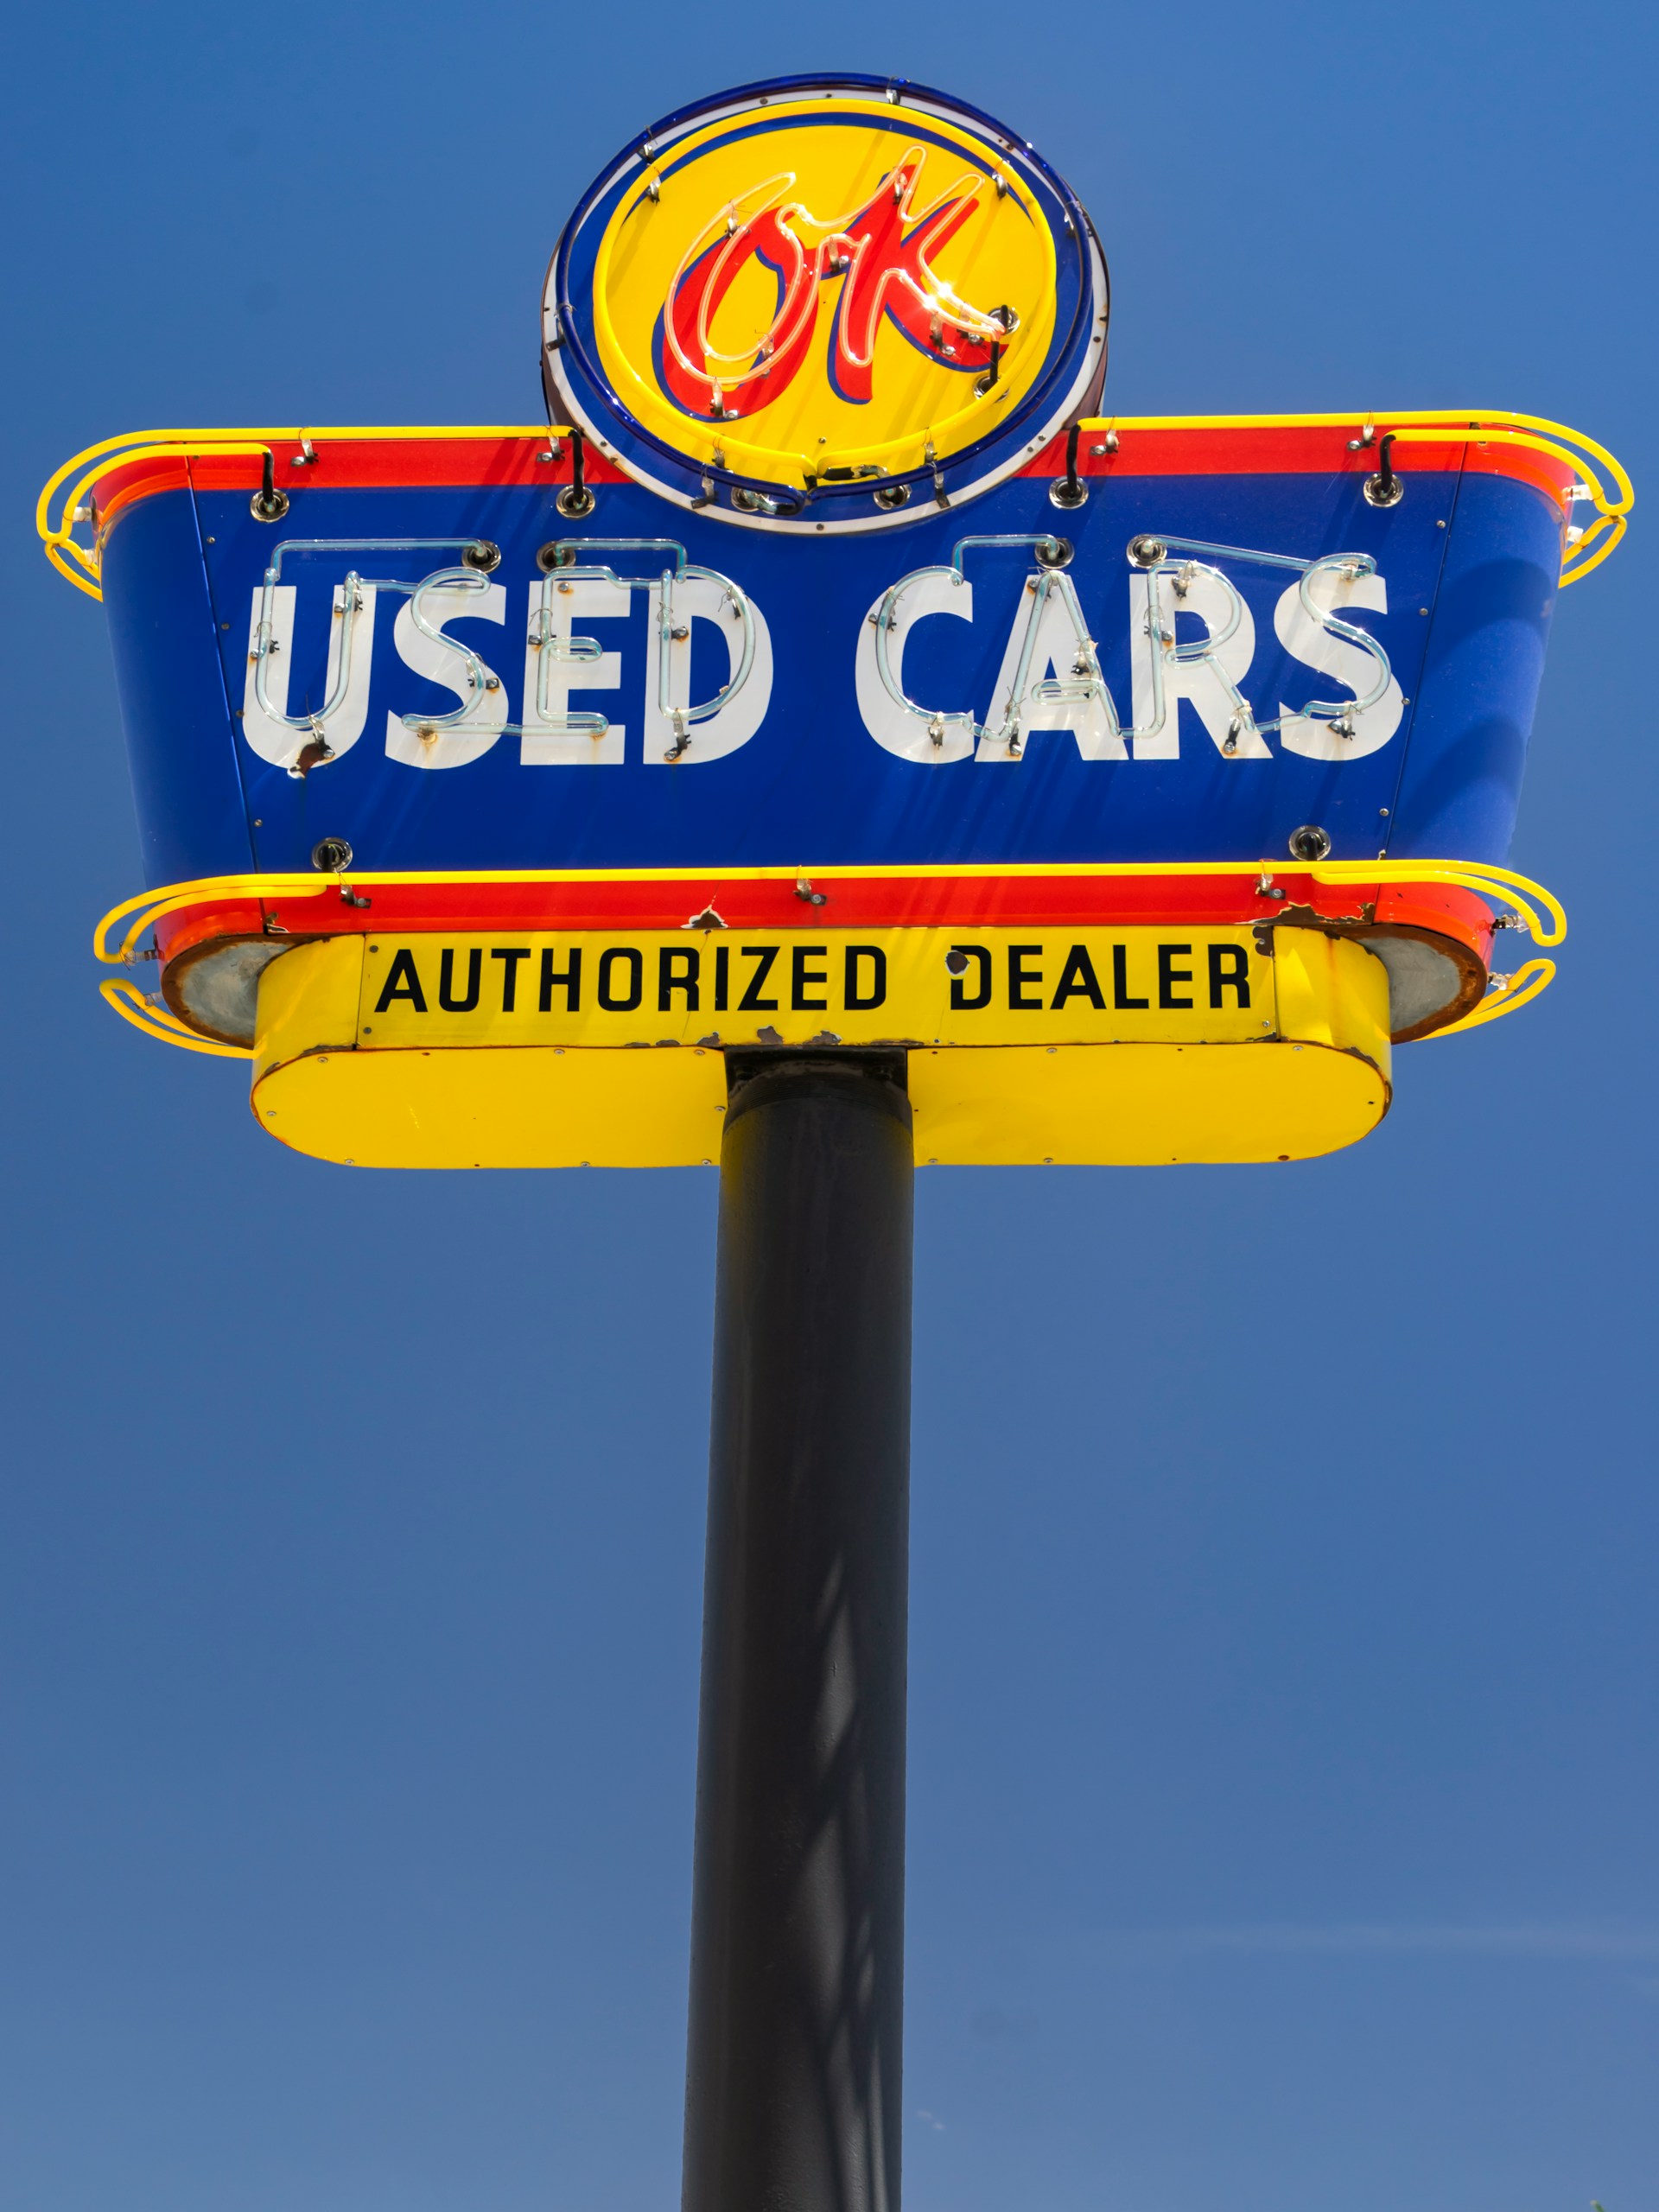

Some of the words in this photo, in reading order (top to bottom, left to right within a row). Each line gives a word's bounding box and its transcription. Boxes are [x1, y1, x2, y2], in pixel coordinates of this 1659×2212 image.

[651, 145, 1008, 423] OK
[242, 568, 774, 772] USED
[855, 563, 1405, 765] CARS
[373, 944, 887, 1013] AUTHORIZED
[947, 943, 1251, 1011] DEALER
